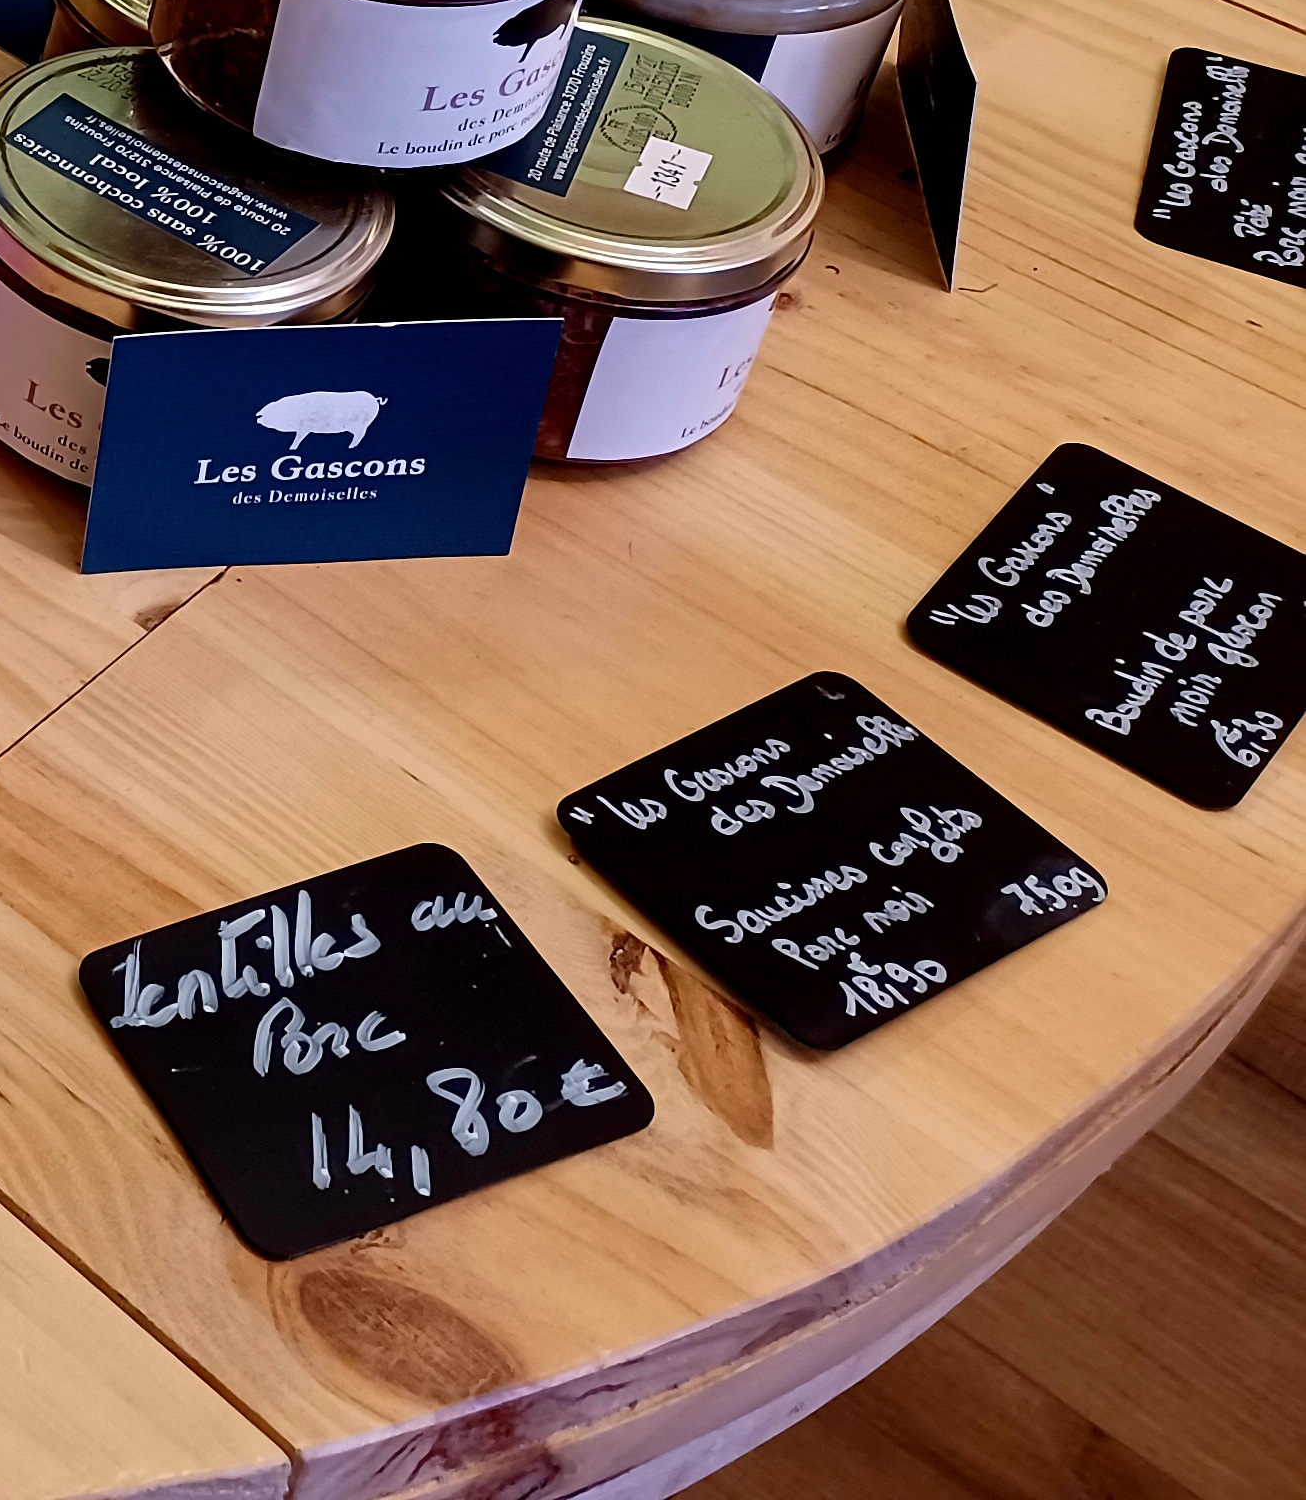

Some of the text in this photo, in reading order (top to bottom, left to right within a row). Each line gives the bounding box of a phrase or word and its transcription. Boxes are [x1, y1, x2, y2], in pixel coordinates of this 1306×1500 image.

[419, 85, 485, 113] Les
[63, 114, 270, 226] route Frouzins
[377, 137, 463, 156] Le boudin
[12, 131, 266, 273] 100% sans cochonneries
[88, 152, 218, 225] 100% local
[26, 379, 84, 430] Les
[12, 424, 66, 464] boudin
[57, 432, 88, 455] des
[193, 453, 427, 485] Les Gascons
[232, 485, 378, 506] des Demoiselles
[1021, 589, 1071, 627] des
[1085, 577, 1233, 736] Boudin de porc
[1170, 592, 1283, 727] noir gascon
[711, 798, 775, 836] des
[411, 891, 497, 931] au
[695, 865, 868, 944] Saucisses
[863, 885, 935, 934] noir
[1000, 866, 1107, 916] 750g
[838, 958, 948, 1017] 18,90
[253, 997, 406, 1077] Porc
